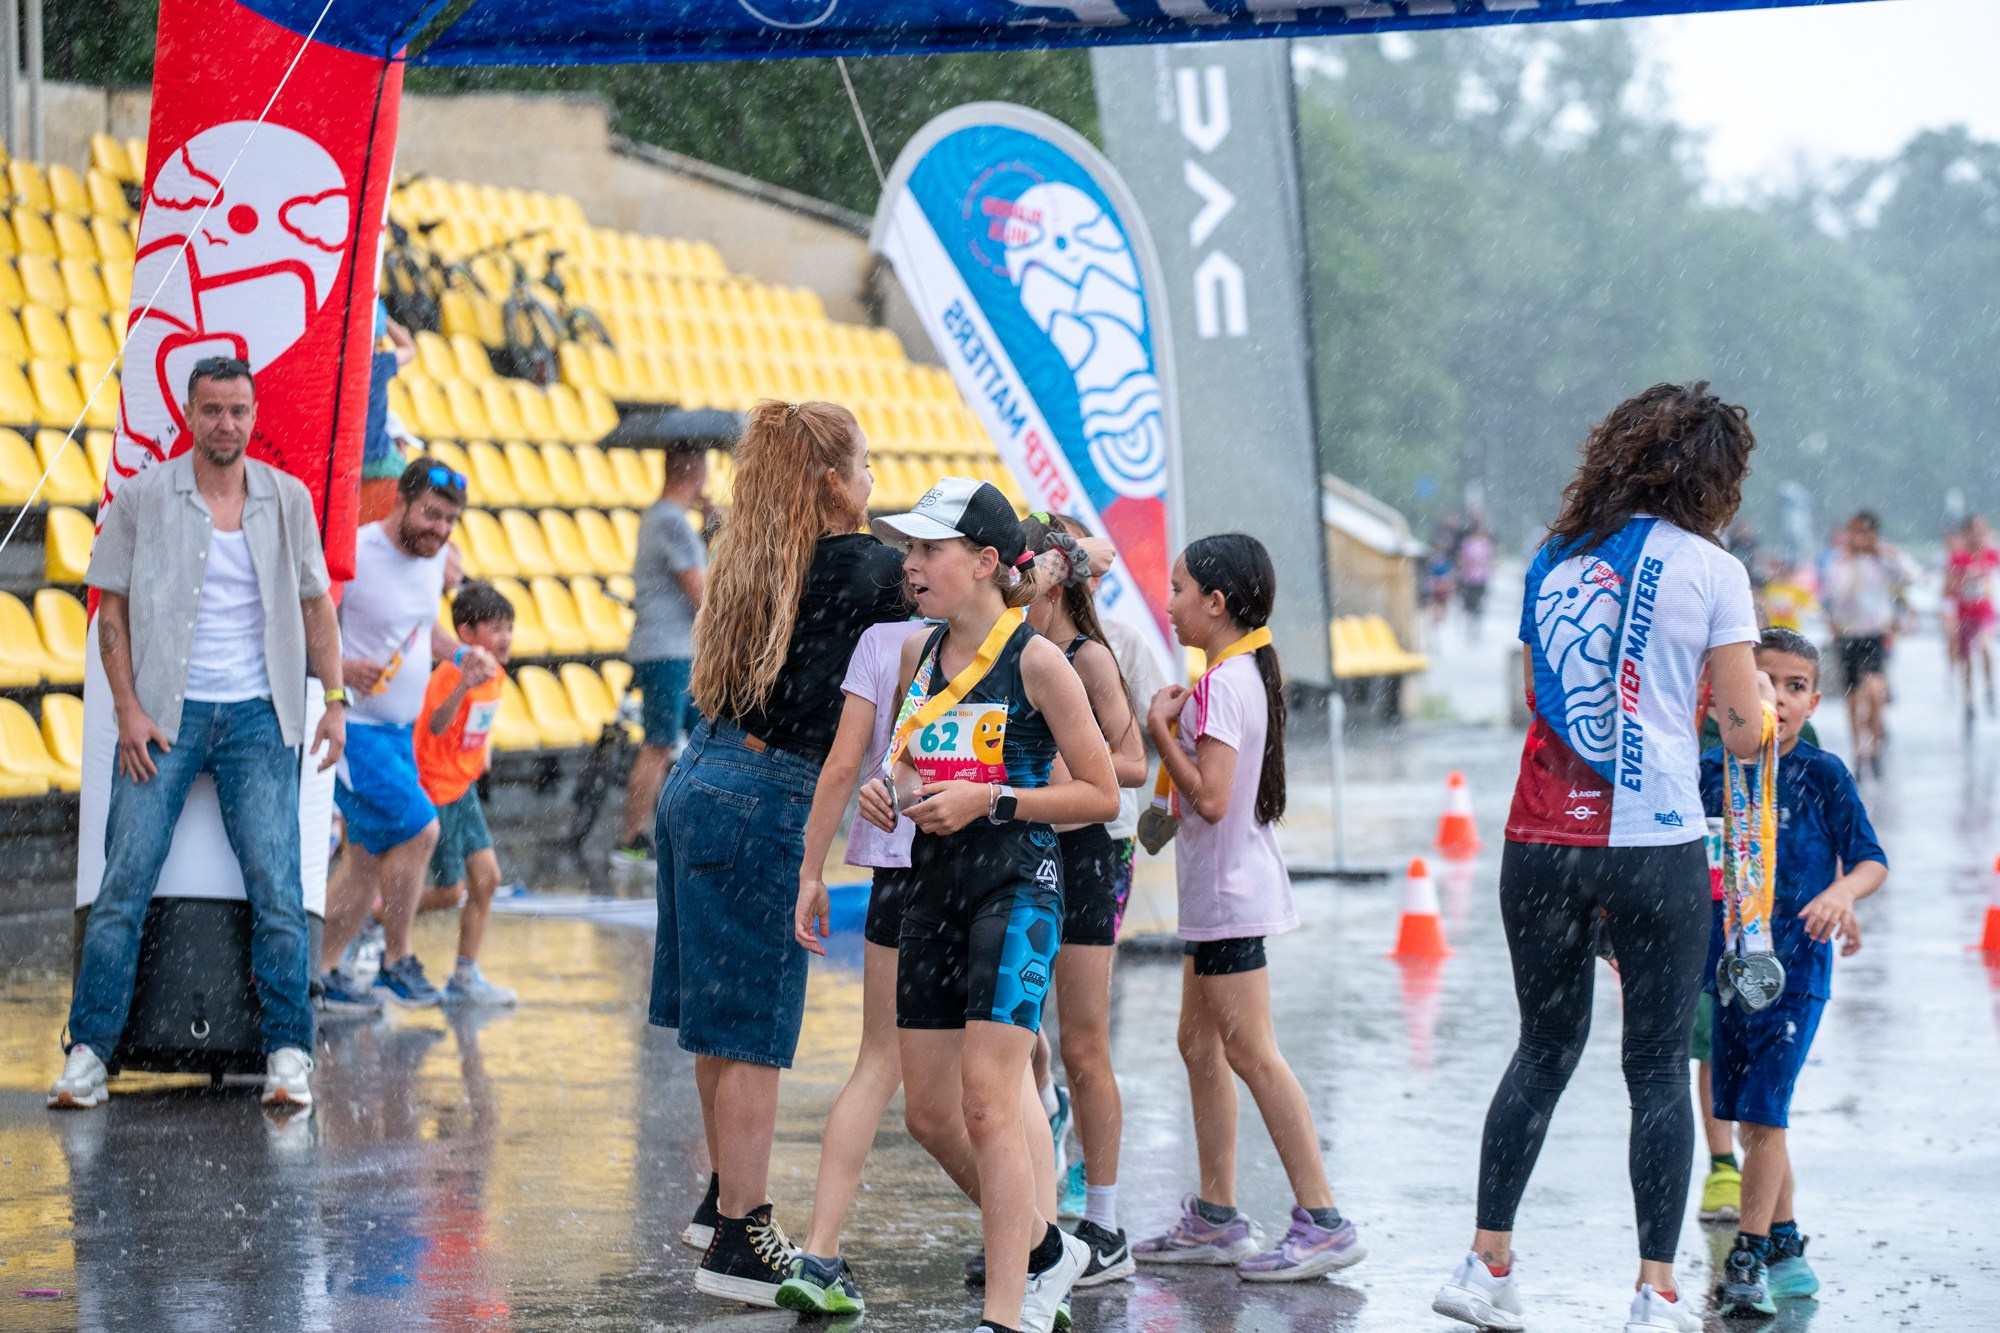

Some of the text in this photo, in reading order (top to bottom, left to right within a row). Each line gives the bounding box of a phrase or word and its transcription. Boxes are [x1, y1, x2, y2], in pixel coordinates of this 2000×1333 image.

[920, 721, 959, 753] 62
[1620, 556, 1664, 793] EVERY STEP MATTERS
